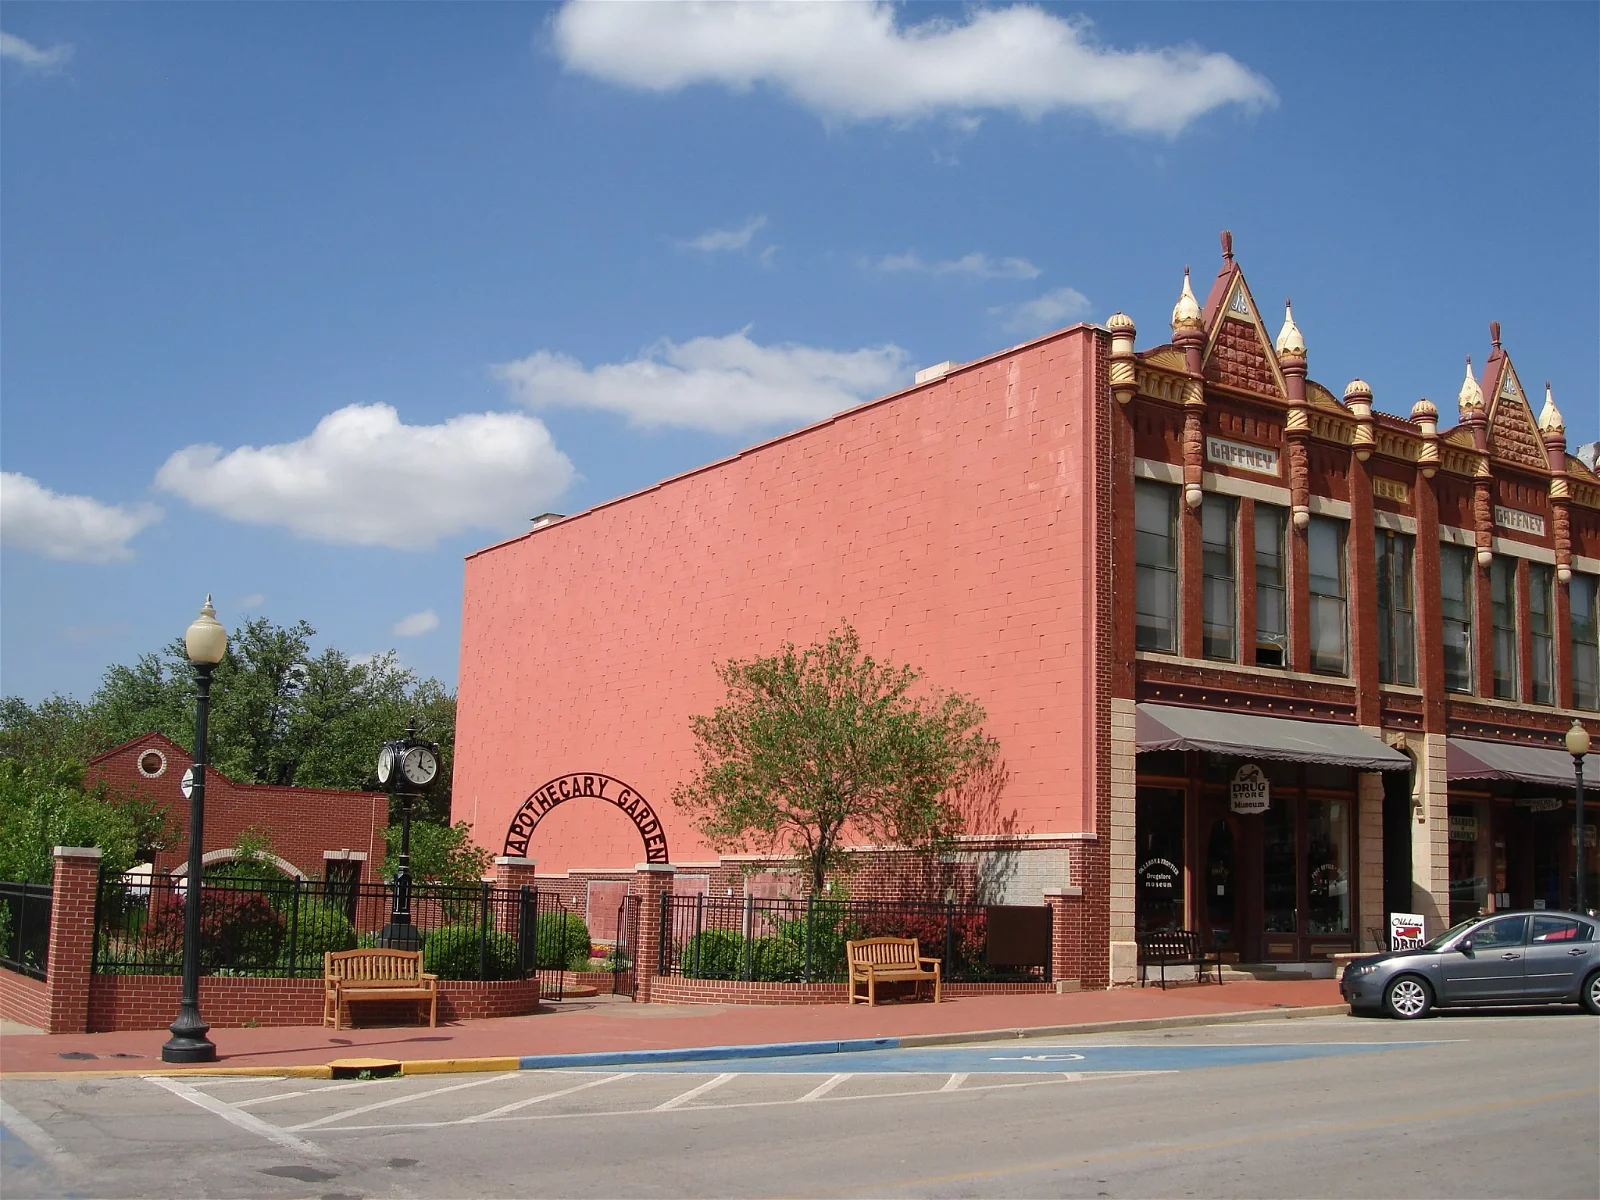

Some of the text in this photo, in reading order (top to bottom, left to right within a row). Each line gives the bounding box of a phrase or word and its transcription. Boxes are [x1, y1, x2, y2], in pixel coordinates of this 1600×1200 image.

[1210, 441, 1273, 470] GAFFNEY
[1374, 479, 1404, 500] 1890
[1495, 508, 1542, 532] GAFFNEY
[1232, 782, 1266, 792] DRUG
[1232, 791, 1265, 799] STORE
[1233, 801, 1265, 809] Museum
[506, 776, 666, 863] APOTHECARY GARDEN
[1160, 858, 1180, 876] FRONTIER
[1146, 873, 1172, 881] Drugstore
